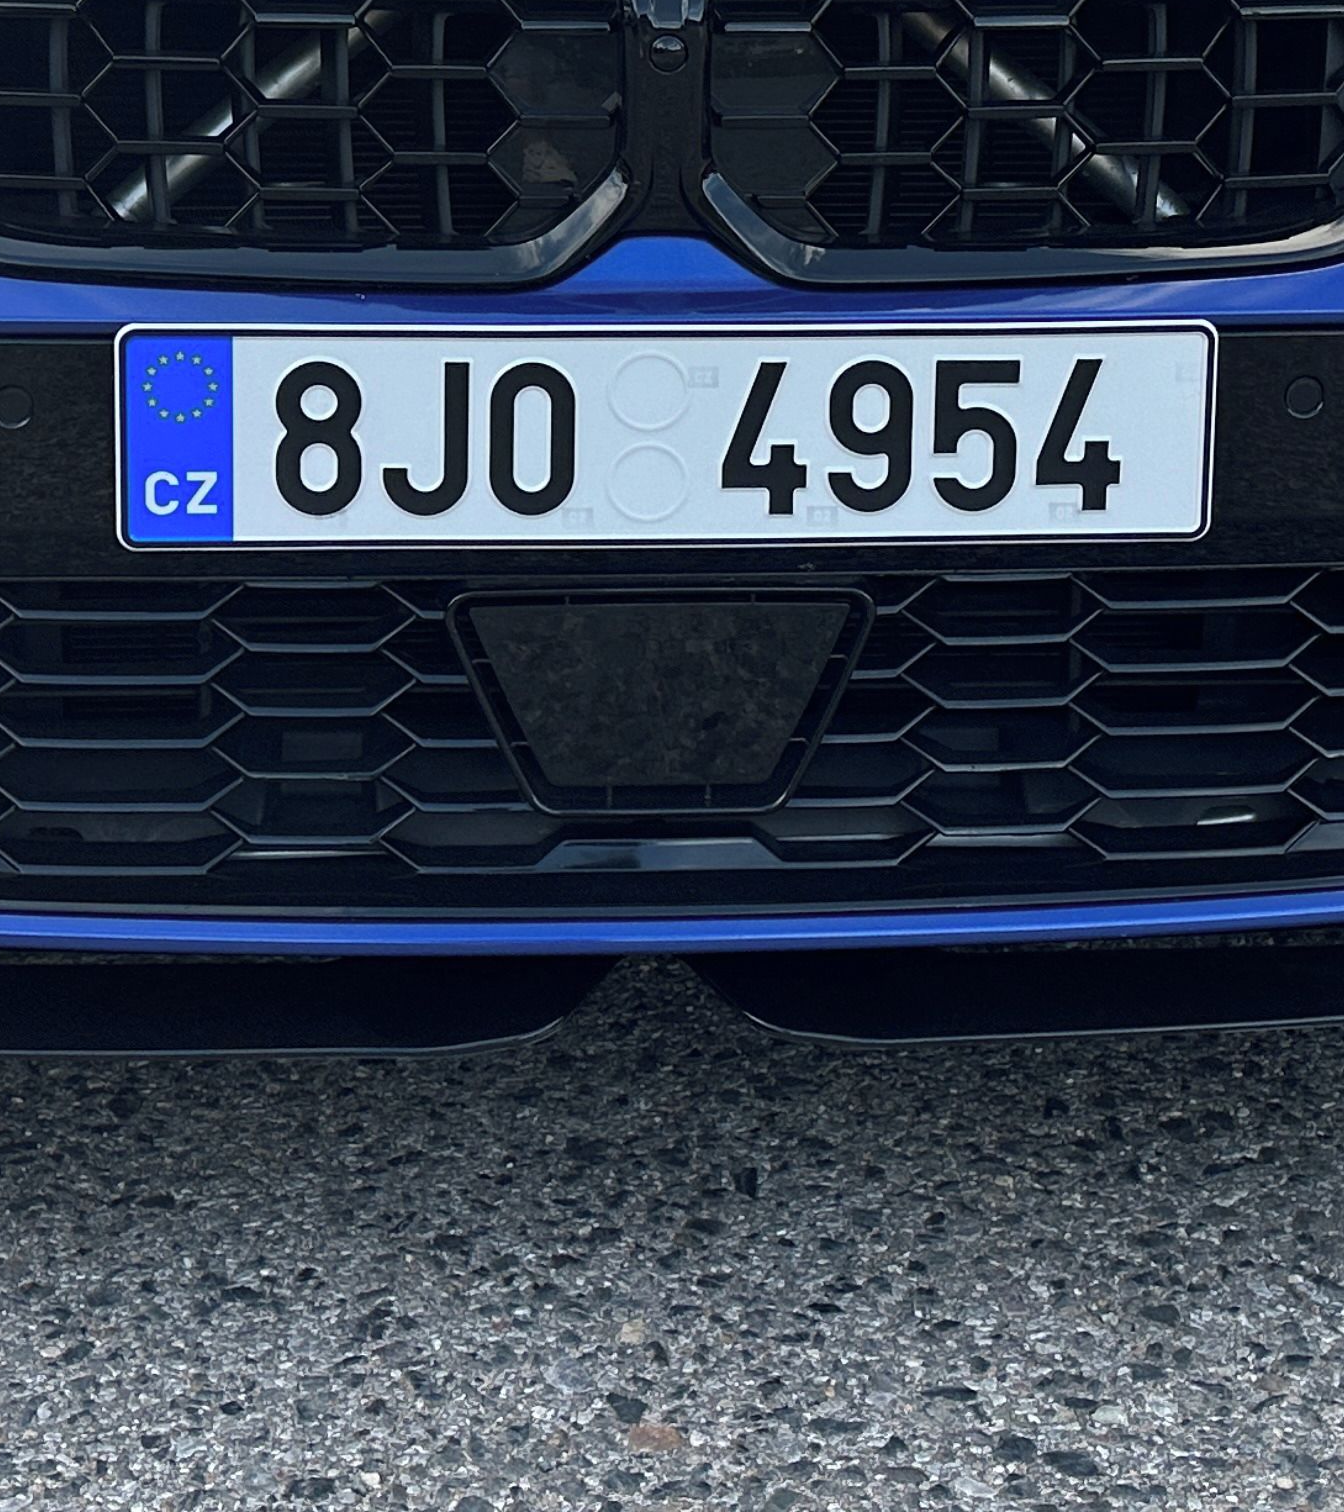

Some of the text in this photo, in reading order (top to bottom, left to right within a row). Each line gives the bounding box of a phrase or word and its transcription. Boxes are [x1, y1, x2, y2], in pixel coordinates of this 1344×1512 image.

[275, 357, 1121, 517] 8J0 4954
[144, 470, 218, 516] CZ
